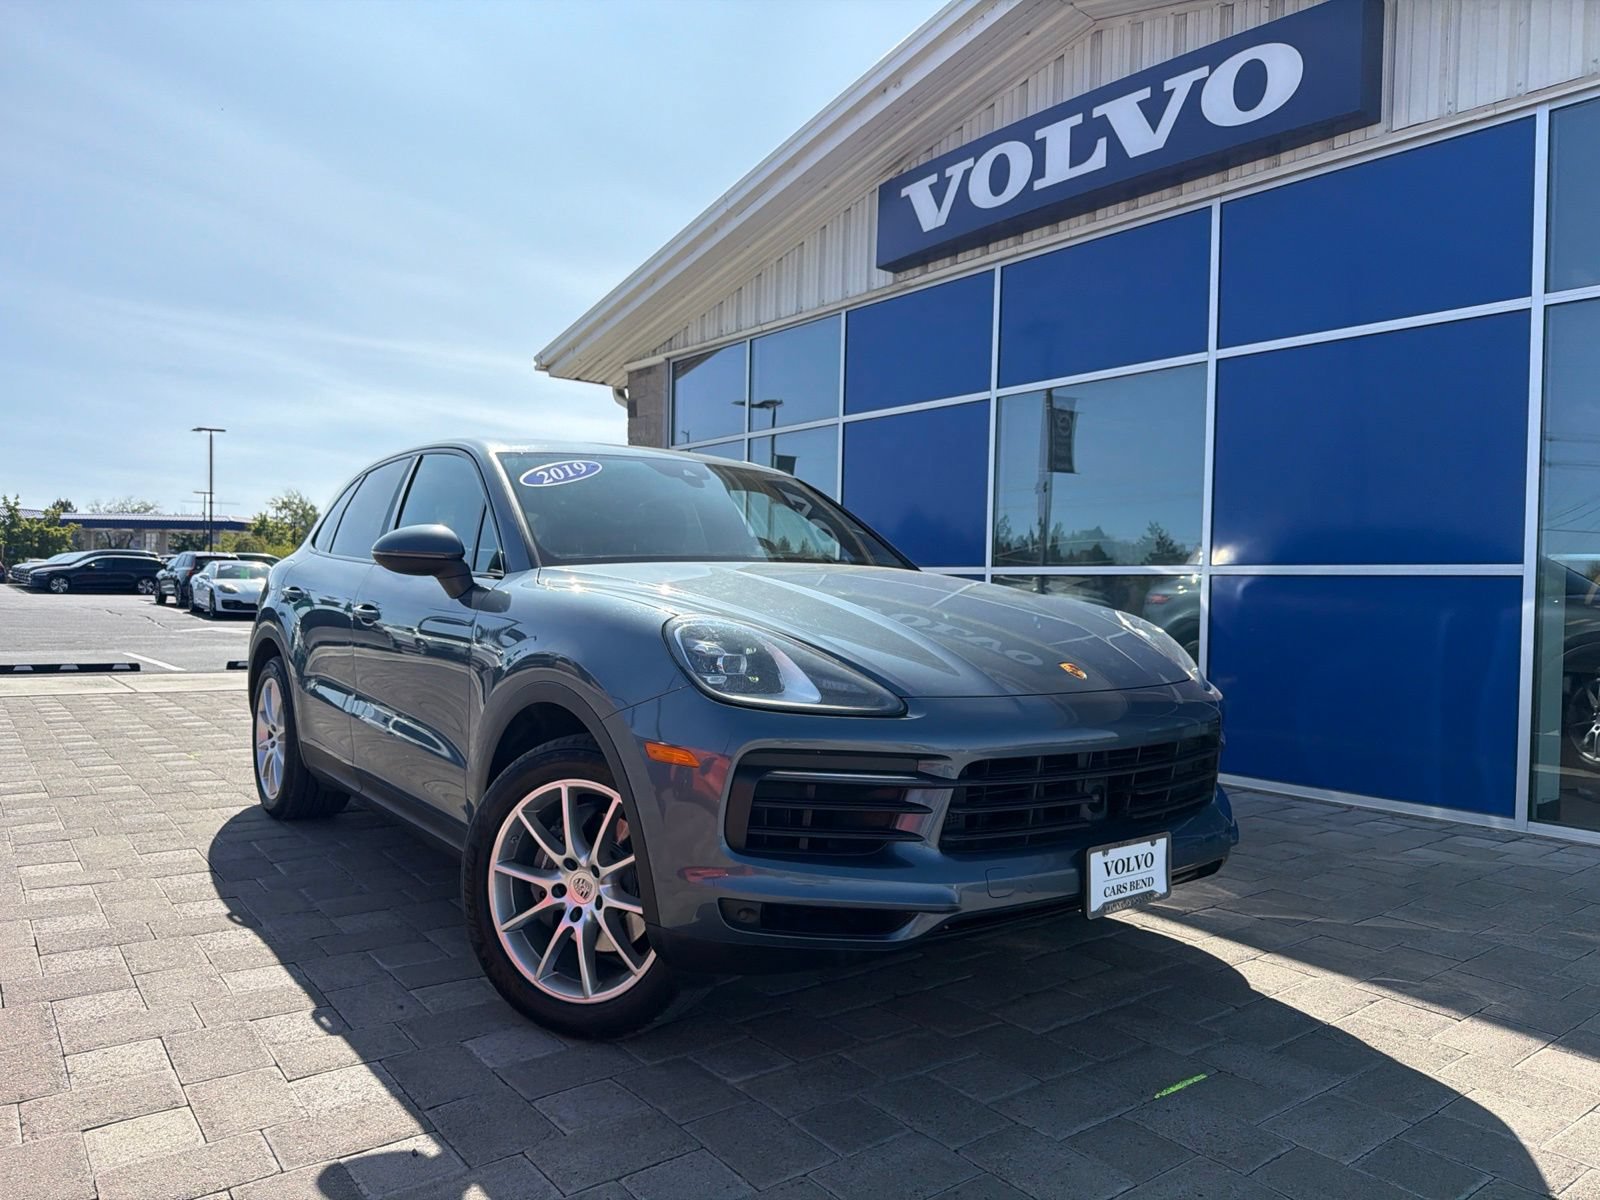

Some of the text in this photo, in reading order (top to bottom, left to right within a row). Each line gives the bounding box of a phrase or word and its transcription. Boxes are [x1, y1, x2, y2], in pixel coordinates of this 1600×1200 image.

[901, 43, 1304, 233] VOLVO
[536, 462, 587, 484] 2019
[1103, 851, 1154, 877] VOLVO
[1103, 876, 1154, 898] CARS BEND
